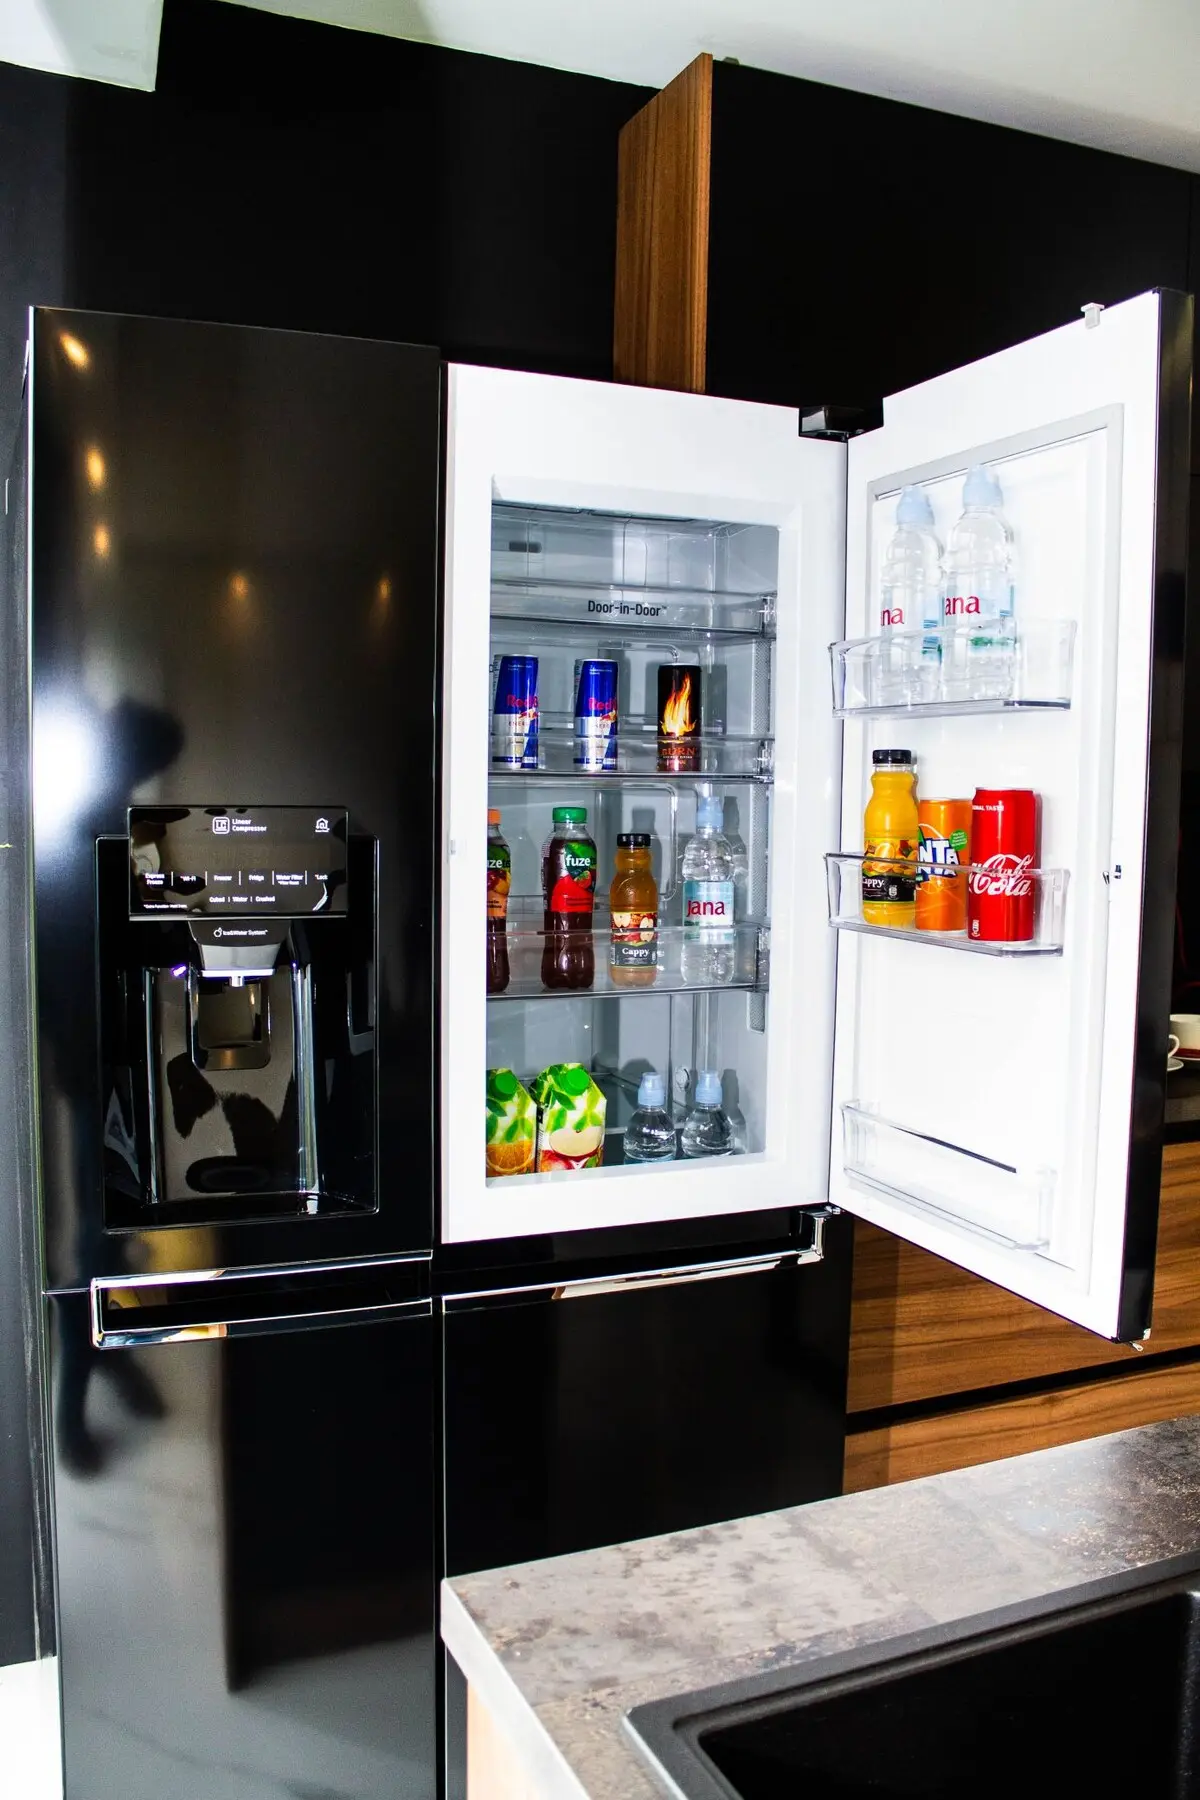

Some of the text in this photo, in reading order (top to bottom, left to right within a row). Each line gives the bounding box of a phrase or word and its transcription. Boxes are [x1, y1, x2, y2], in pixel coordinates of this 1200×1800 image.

[945, 596, 981, 616] ana
[565, 854, 591, 867] fuze
[918, 839, 959, 876] NTA
[622, 947, 650, 958] Cappy
